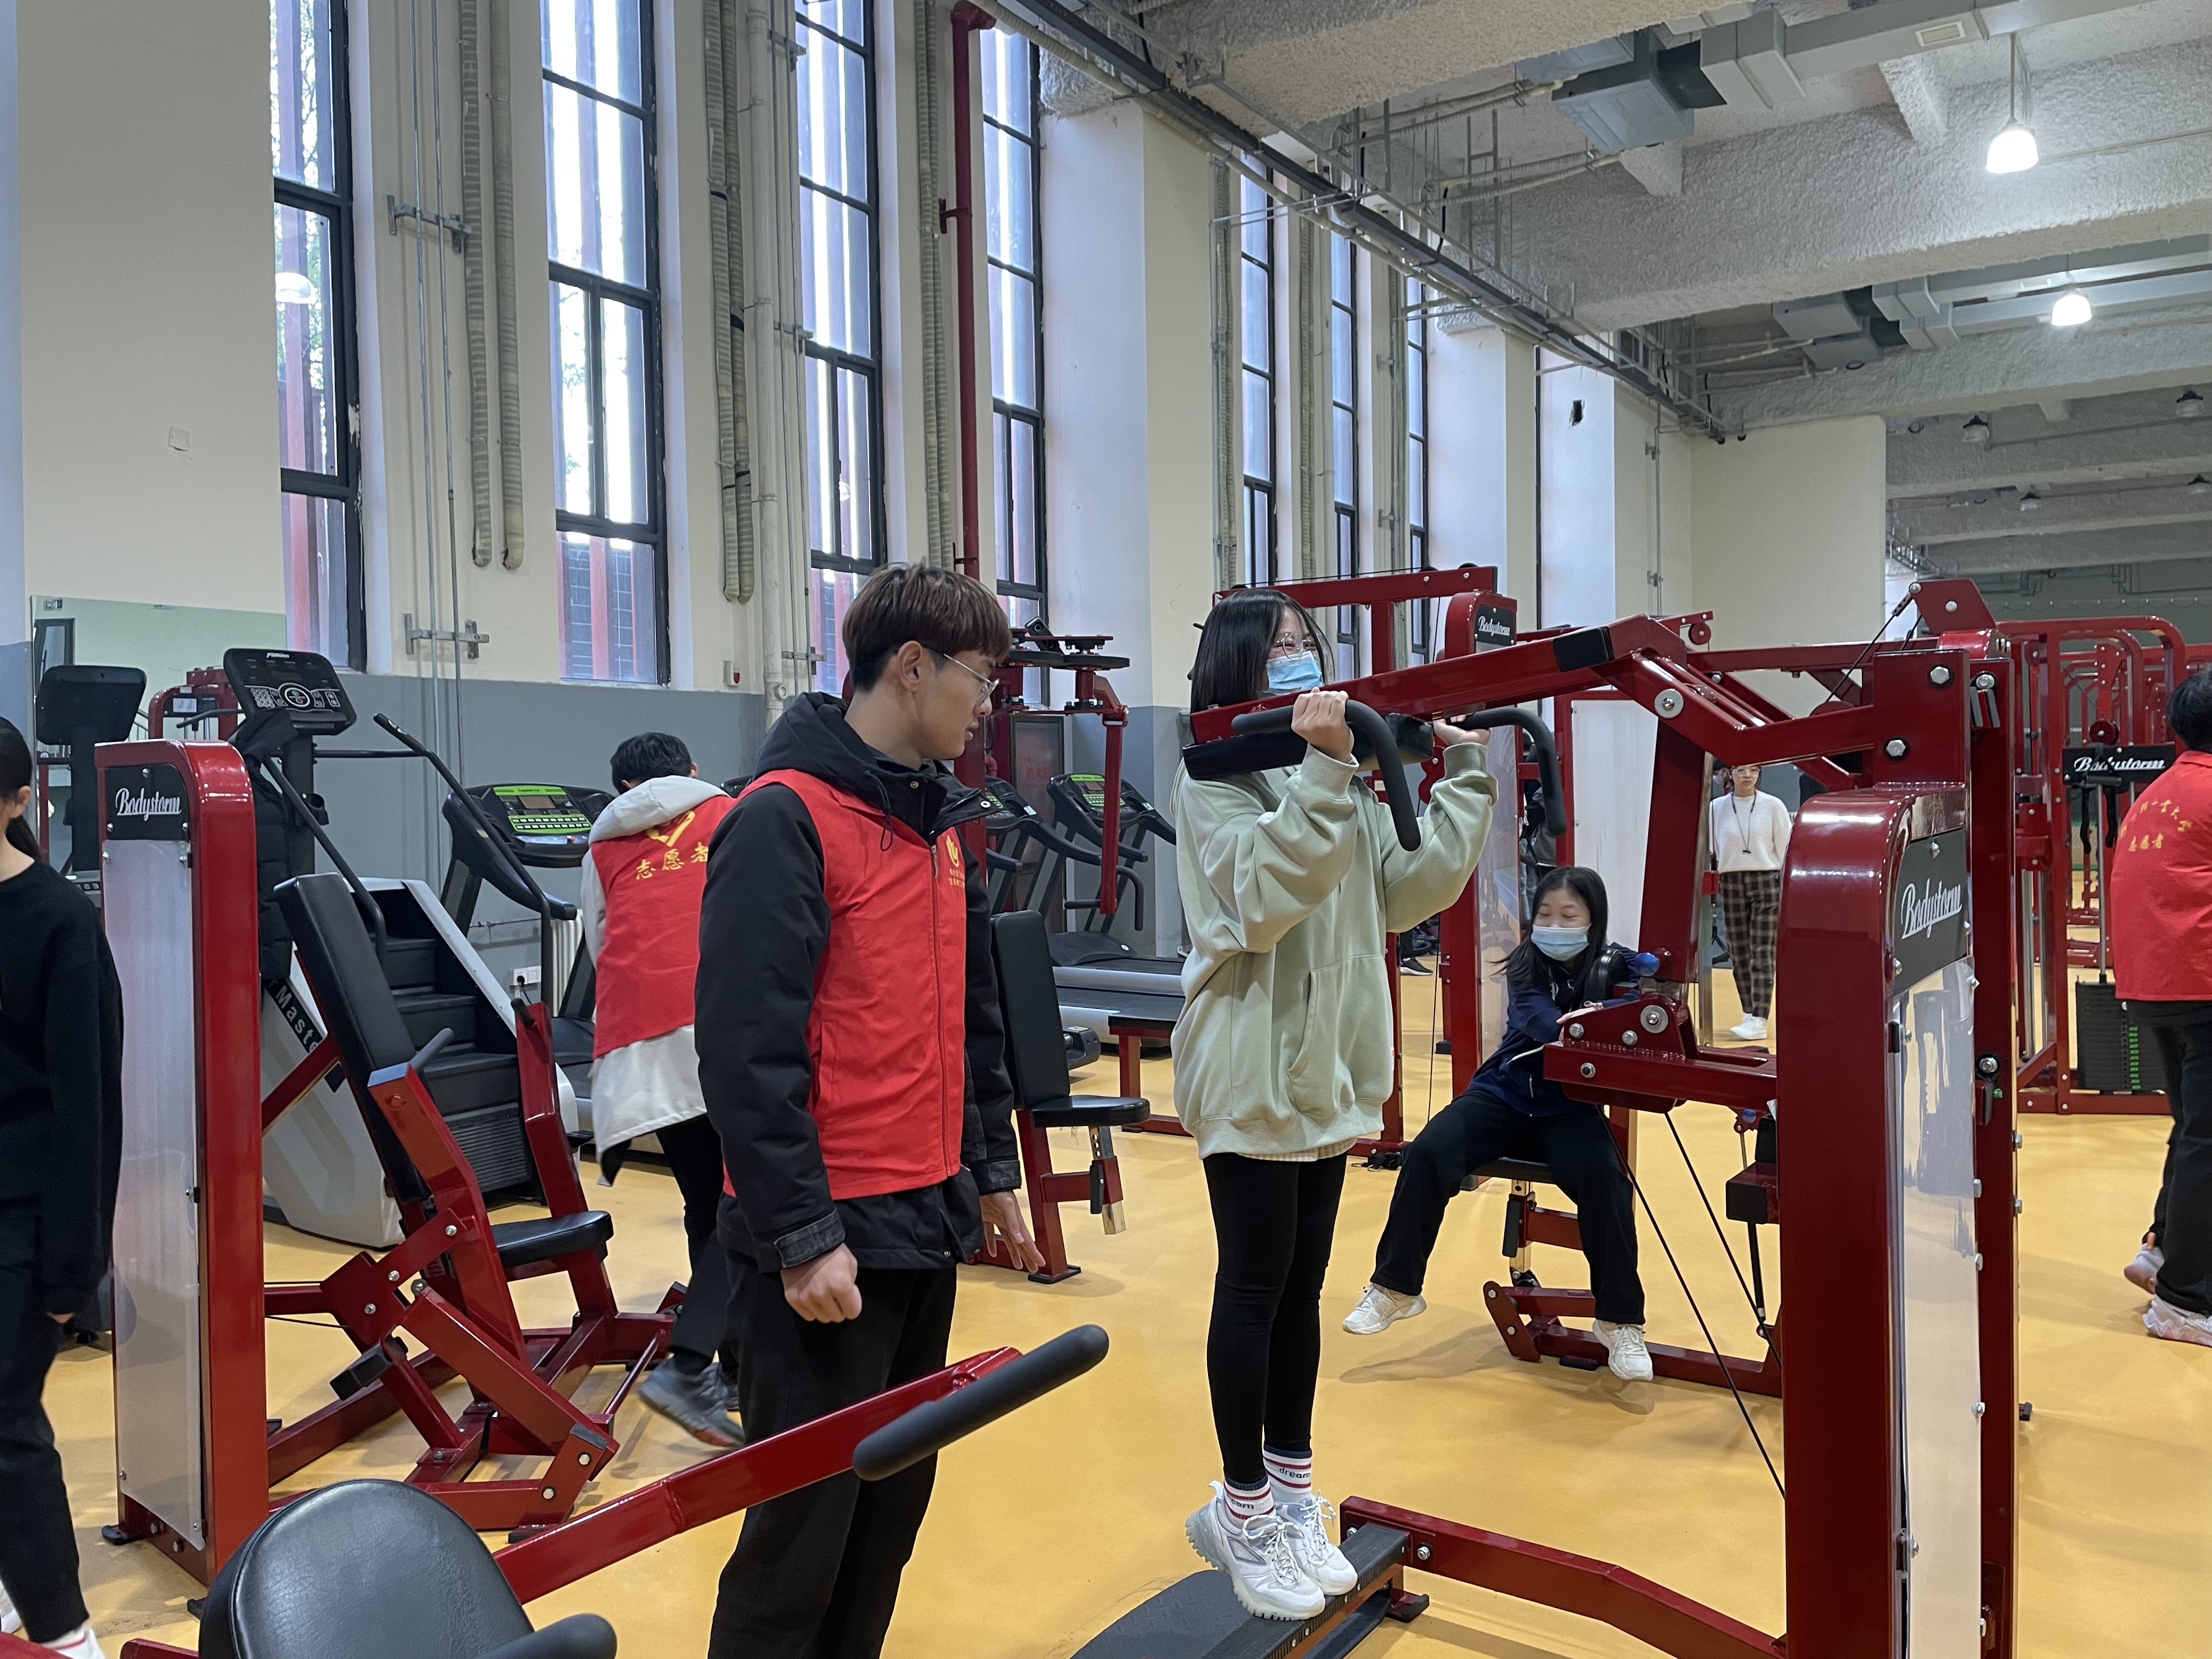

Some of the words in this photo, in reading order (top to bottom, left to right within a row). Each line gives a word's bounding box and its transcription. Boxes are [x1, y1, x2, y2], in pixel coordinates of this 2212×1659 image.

[1479, 616, 1510, 636] Bodystorm
[115, 787, 182, 821] Bodystorm
[636, 842, 709, 880] 志愿者
[1901, 878, 1962, 939] Bodystorm
[275, 985, 319, 1052] Maste
[1279, 1468, 1311, 1479] dream
